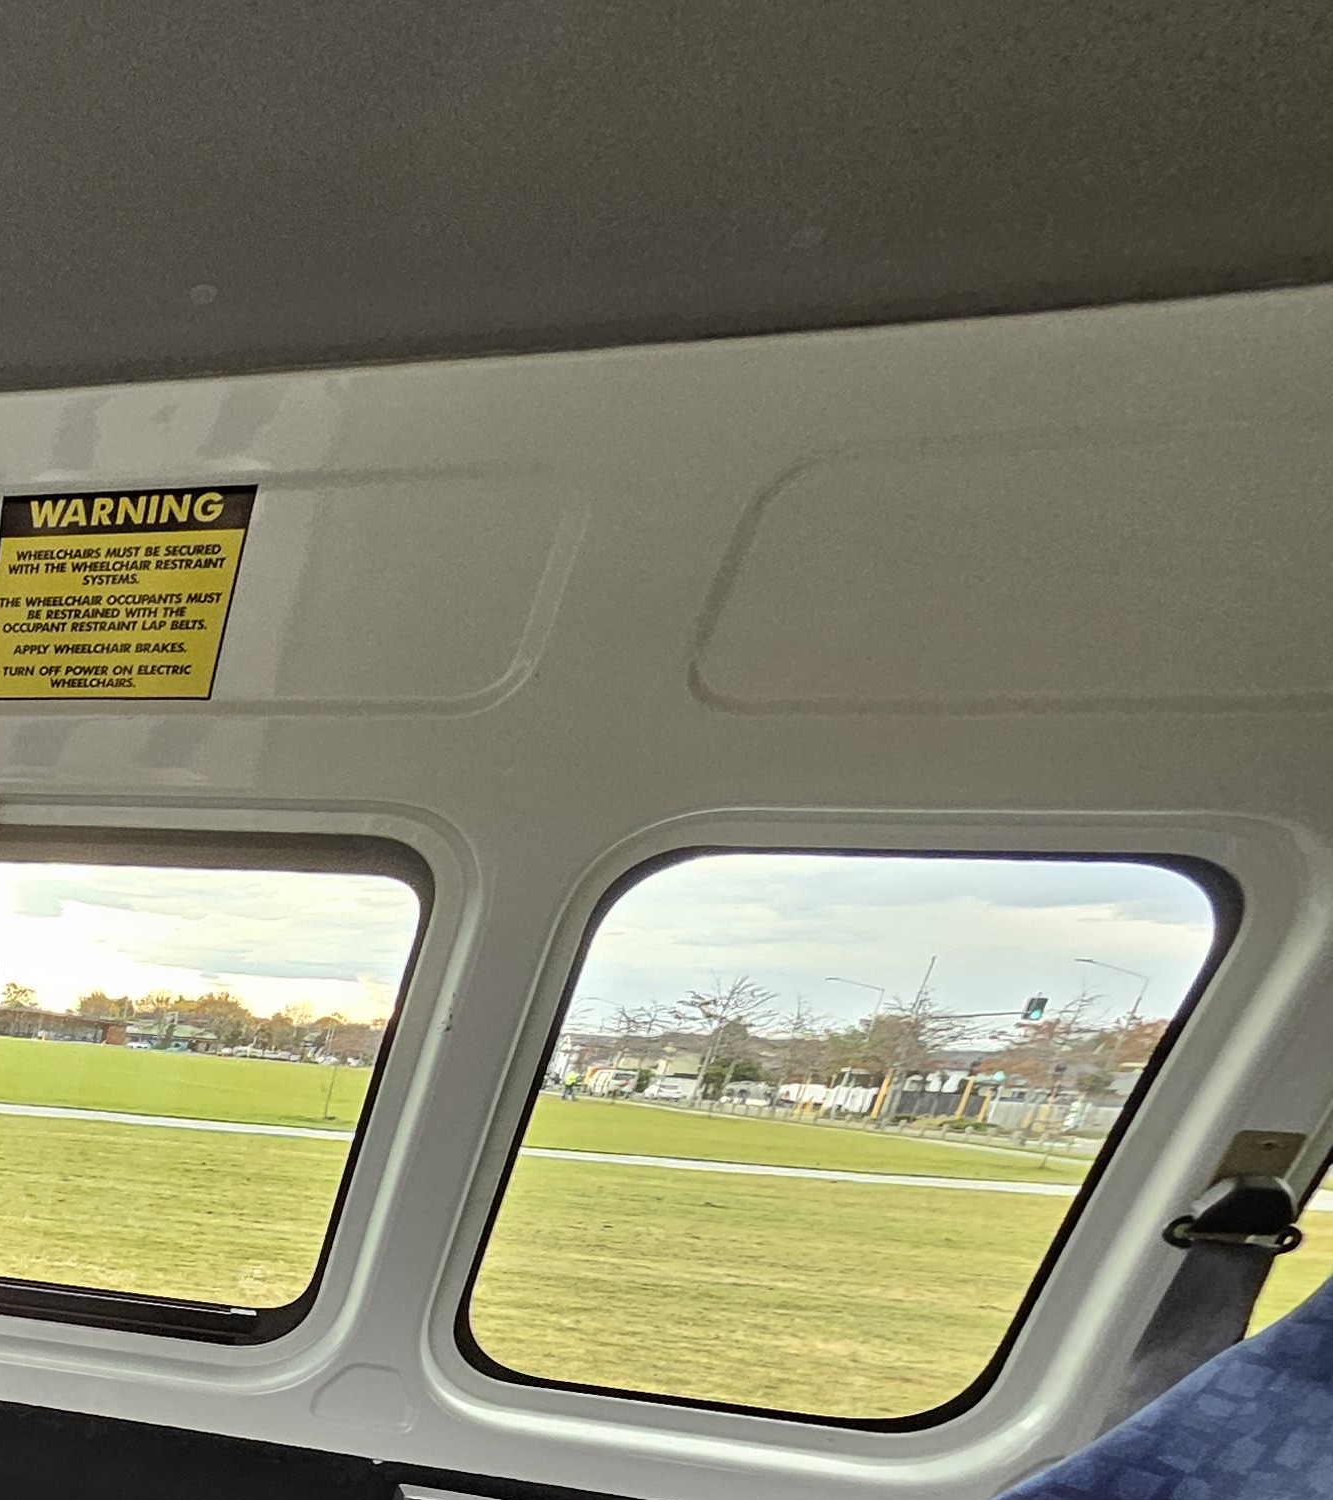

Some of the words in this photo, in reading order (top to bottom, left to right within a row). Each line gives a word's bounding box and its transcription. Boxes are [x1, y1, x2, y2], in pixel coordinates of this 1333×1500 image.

[30, 492, 225, 528] WARNING
[16, 548, 101, 561] WHEELCHAIRS
[104, 546, 141, 559] MUST
[144, 545, 161, 557] BE
[164, 543, 222, 556] SECURED
[8, 563, 40, 575] WITH
[44, 562, 68, 574] THE
[71, 559, 152, 573] WHEELCHAIR
[154, 557, 227, 570] RESTRAINT
[82, 573, 141, 586] SYSTEMS.
[0, 597, 22, 608] THE
[25, 595, 103, 607] WHEELCHAIR
[106, 593, 183, 606] OCCUPANTS
[185, 592, 223, 604] MUST
[26, 609, 42, 620] BE
[45, 607, 121, 619] RESTRAINED
[124, 607, 159, 619] WITH
[162, 606, 188, 618] THE
[2, 622, 67, 634] OCCUPANT
[70, 620, 139, 633] RESTRAINT
[141, 620, 168, 632] LAP
[170, 619, 208, 631] BELTS.
[13, 644, 50, 656] APPLY
[53, 643, 132, 655] WHEELCHAIR
[2, 666, 35, 677] TURN
[38, 666, 62, 677] OFF
[64, 666, 109, 676] POWER
[112, 666, 133, 676] ON
[136, 664, 193, 676] ELECTRIC
